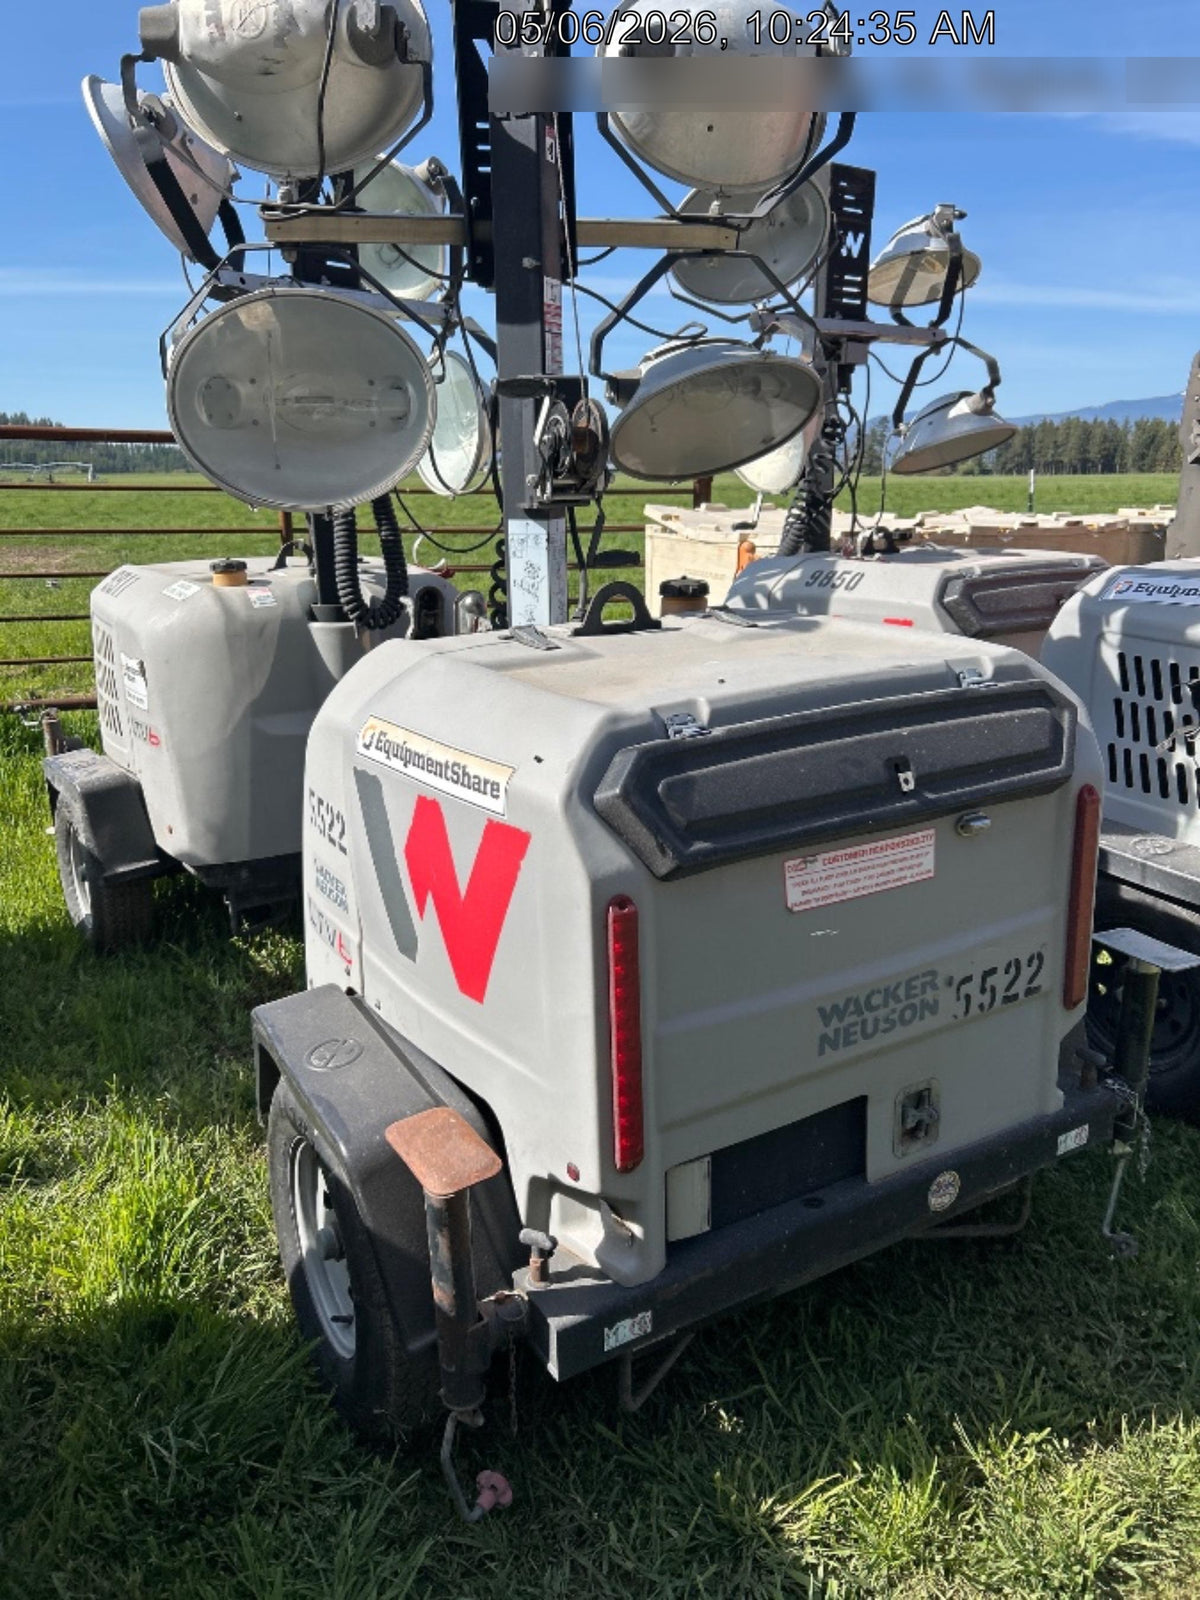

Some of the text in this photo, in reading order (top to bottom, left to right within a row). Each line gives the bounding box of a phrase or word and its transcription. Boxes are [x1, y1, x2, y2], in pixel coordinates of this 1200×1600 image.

[805, 569, 865, 591] 9850
[374, 729, 501, 800] EquipmentShare
[816, 969, 940, 1029] WACKER
[817, 998, 940, 1057] NEUSON
